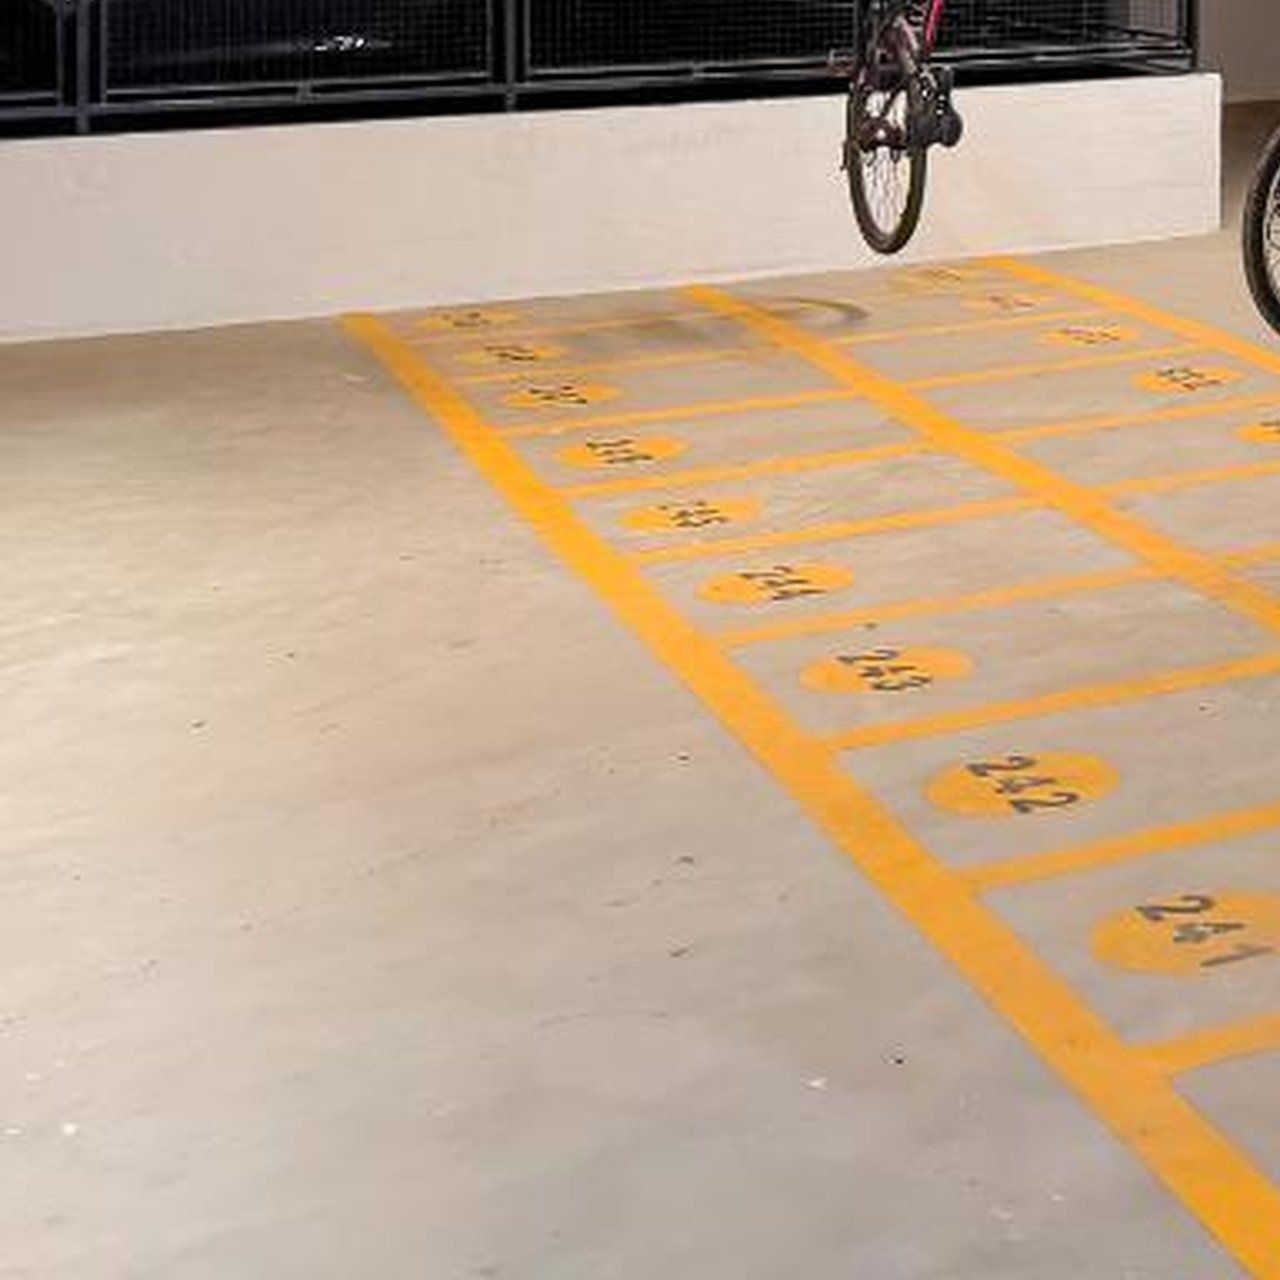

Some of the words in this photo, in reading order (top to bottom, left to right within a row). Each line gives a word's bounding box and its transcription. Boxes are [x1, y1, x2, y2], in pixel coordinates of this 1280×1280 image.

[835, 648, 935, 693] 243
[965, 755, 1081, 816] 242
[1133, 894, 1275, 968] 241
